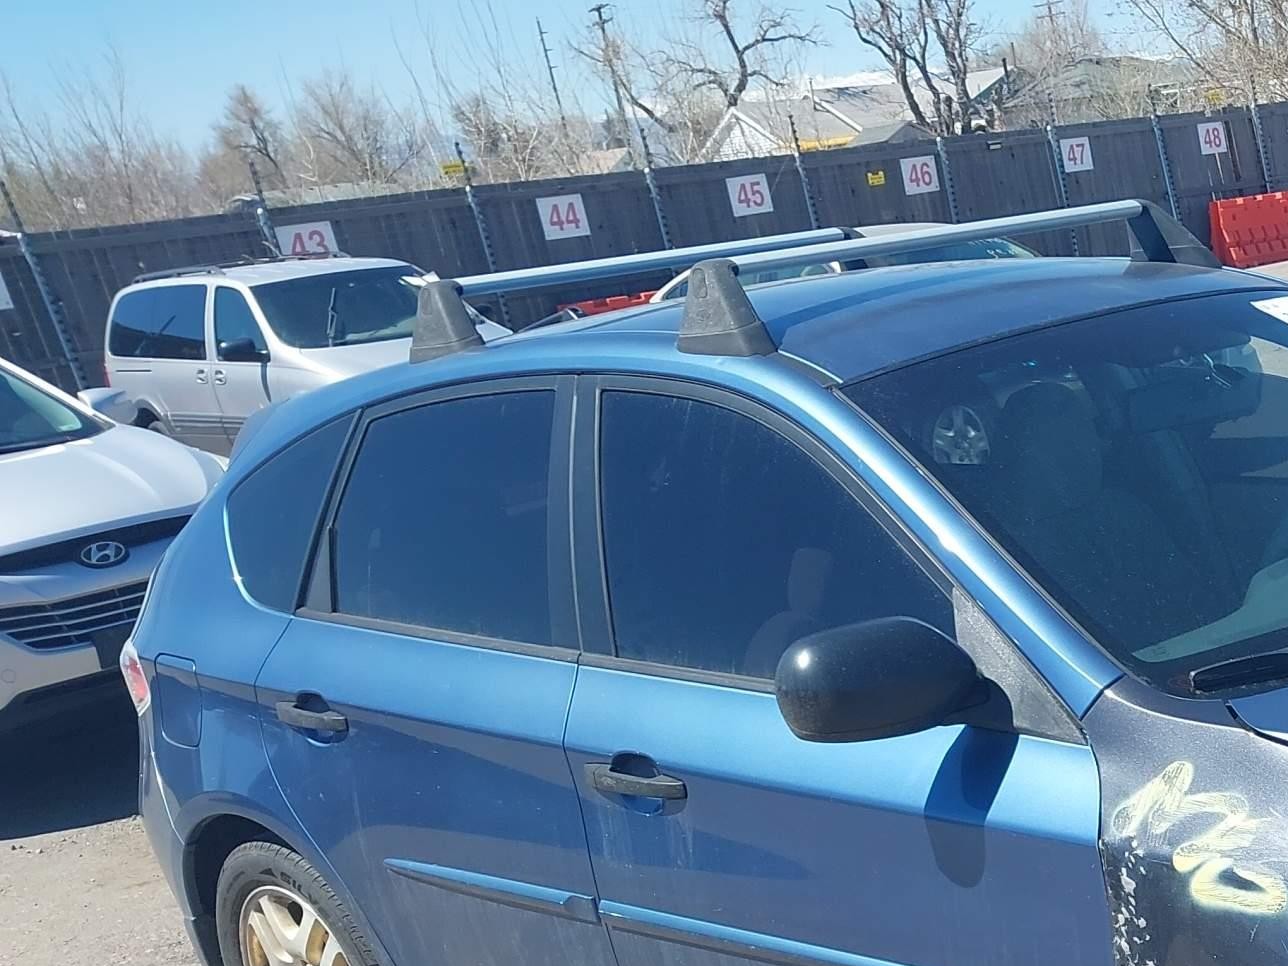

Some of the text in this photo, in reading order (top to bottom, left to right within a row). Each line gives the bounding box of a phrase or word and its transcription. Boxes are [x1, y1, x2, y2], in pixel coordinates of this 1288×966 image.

[1203, 127, 1222, 148] 48
[1067, 143, 1086, 166] 47
[908, 162, 932, 188] 46
[737, 181, 765, 208] 45
[549, 201, 581, 231] 44
[291, 230, 330, 258] 43
